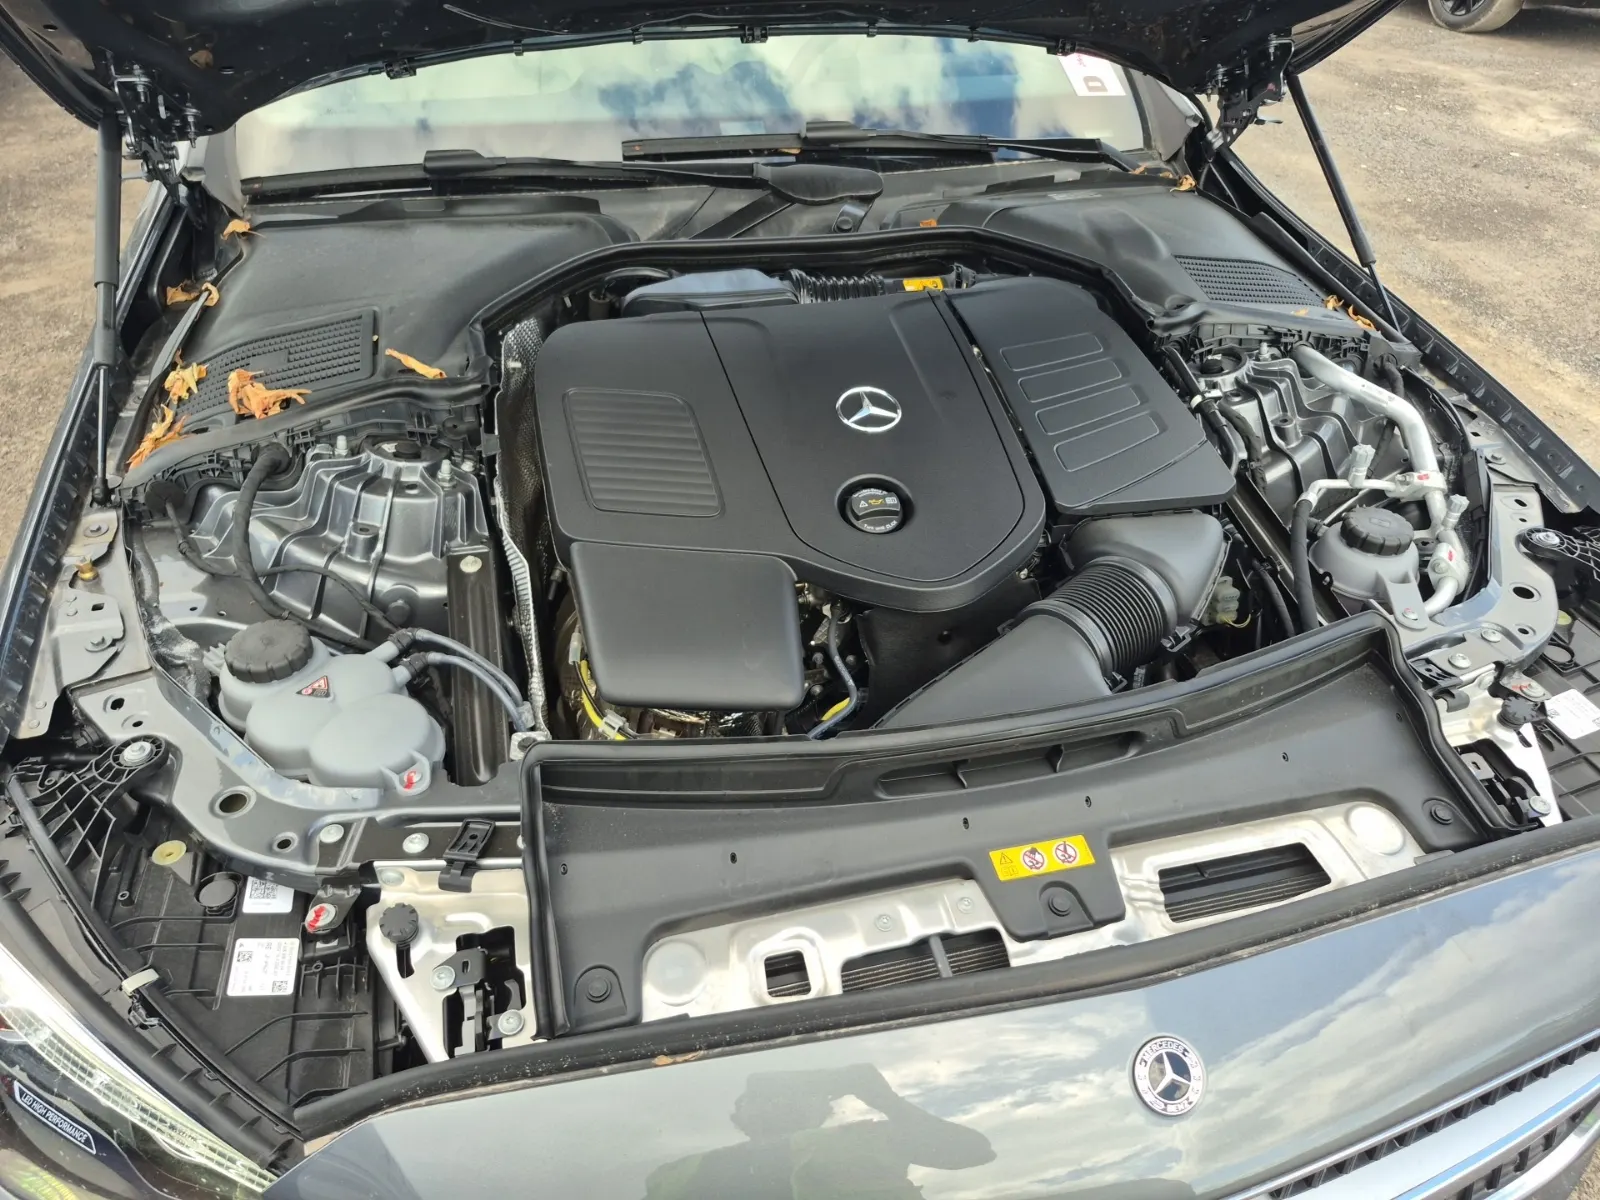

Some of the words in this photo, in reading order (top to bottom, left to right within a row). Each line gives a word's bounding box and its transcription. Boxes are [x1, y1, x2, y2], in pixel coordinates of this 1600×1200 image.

[885, 520, 897, 529] CLICK
[1143, 1040, 1184, 1060] MERCEDES
[21, 1093, 32, 1105] LED
[31, 1101, 46, 1116] HIGH
[45, 1110, 88, 1143] PERFORMANCE
